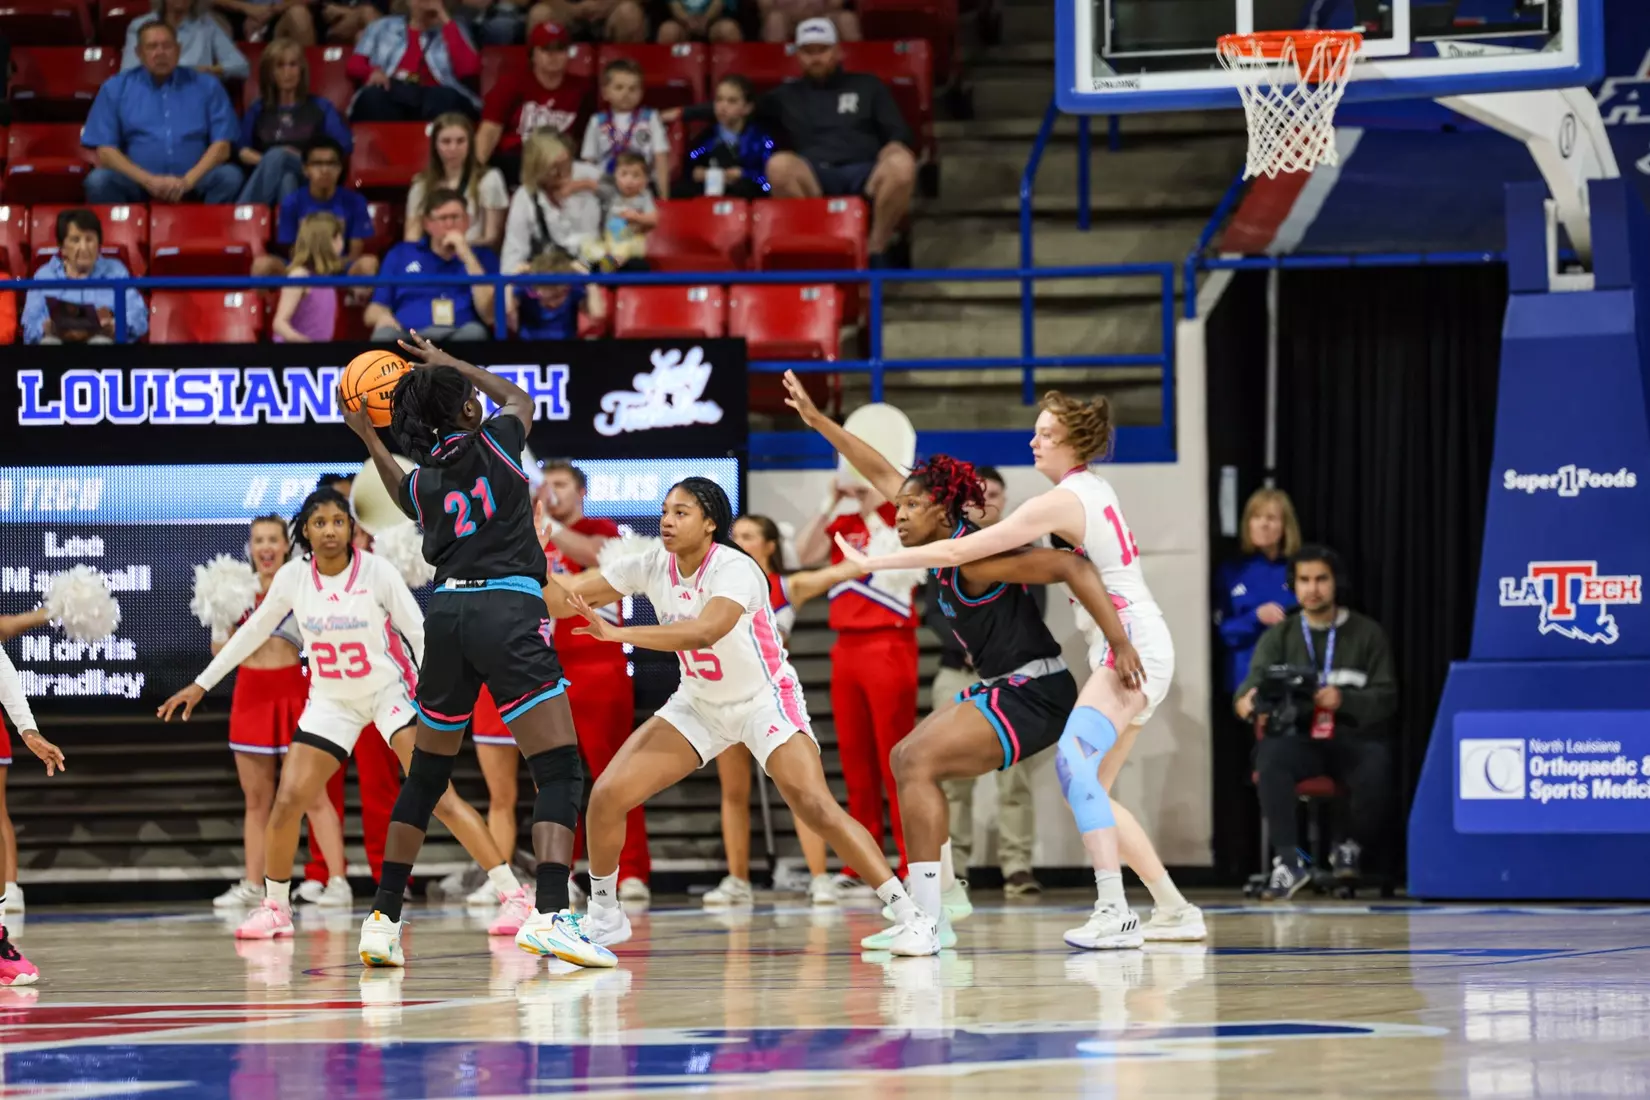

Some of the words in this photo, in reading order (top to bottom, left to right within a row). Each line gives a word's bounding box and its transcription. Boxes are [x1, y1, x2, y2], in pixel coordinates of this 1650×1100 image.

[18, 368, 347, 426] LOUISIAN
[1503, 468, 1560, 495] Super
[1557, 463, 1580, 497] 1
[1577, 467, 1637, 489] Foods
[443, 476, 497, 539] 21
[1103, 505, 1140, 567] 1
[22, 633, 137, 662] Morris
[310, 641, 373, 679] 23
[677, 644, 724, 681] 15
[1529, 738, 1564, 754] North
[1529, 755, 1638, 781] Orthopaedic
[1529, 778, 1589, 804] Sports
